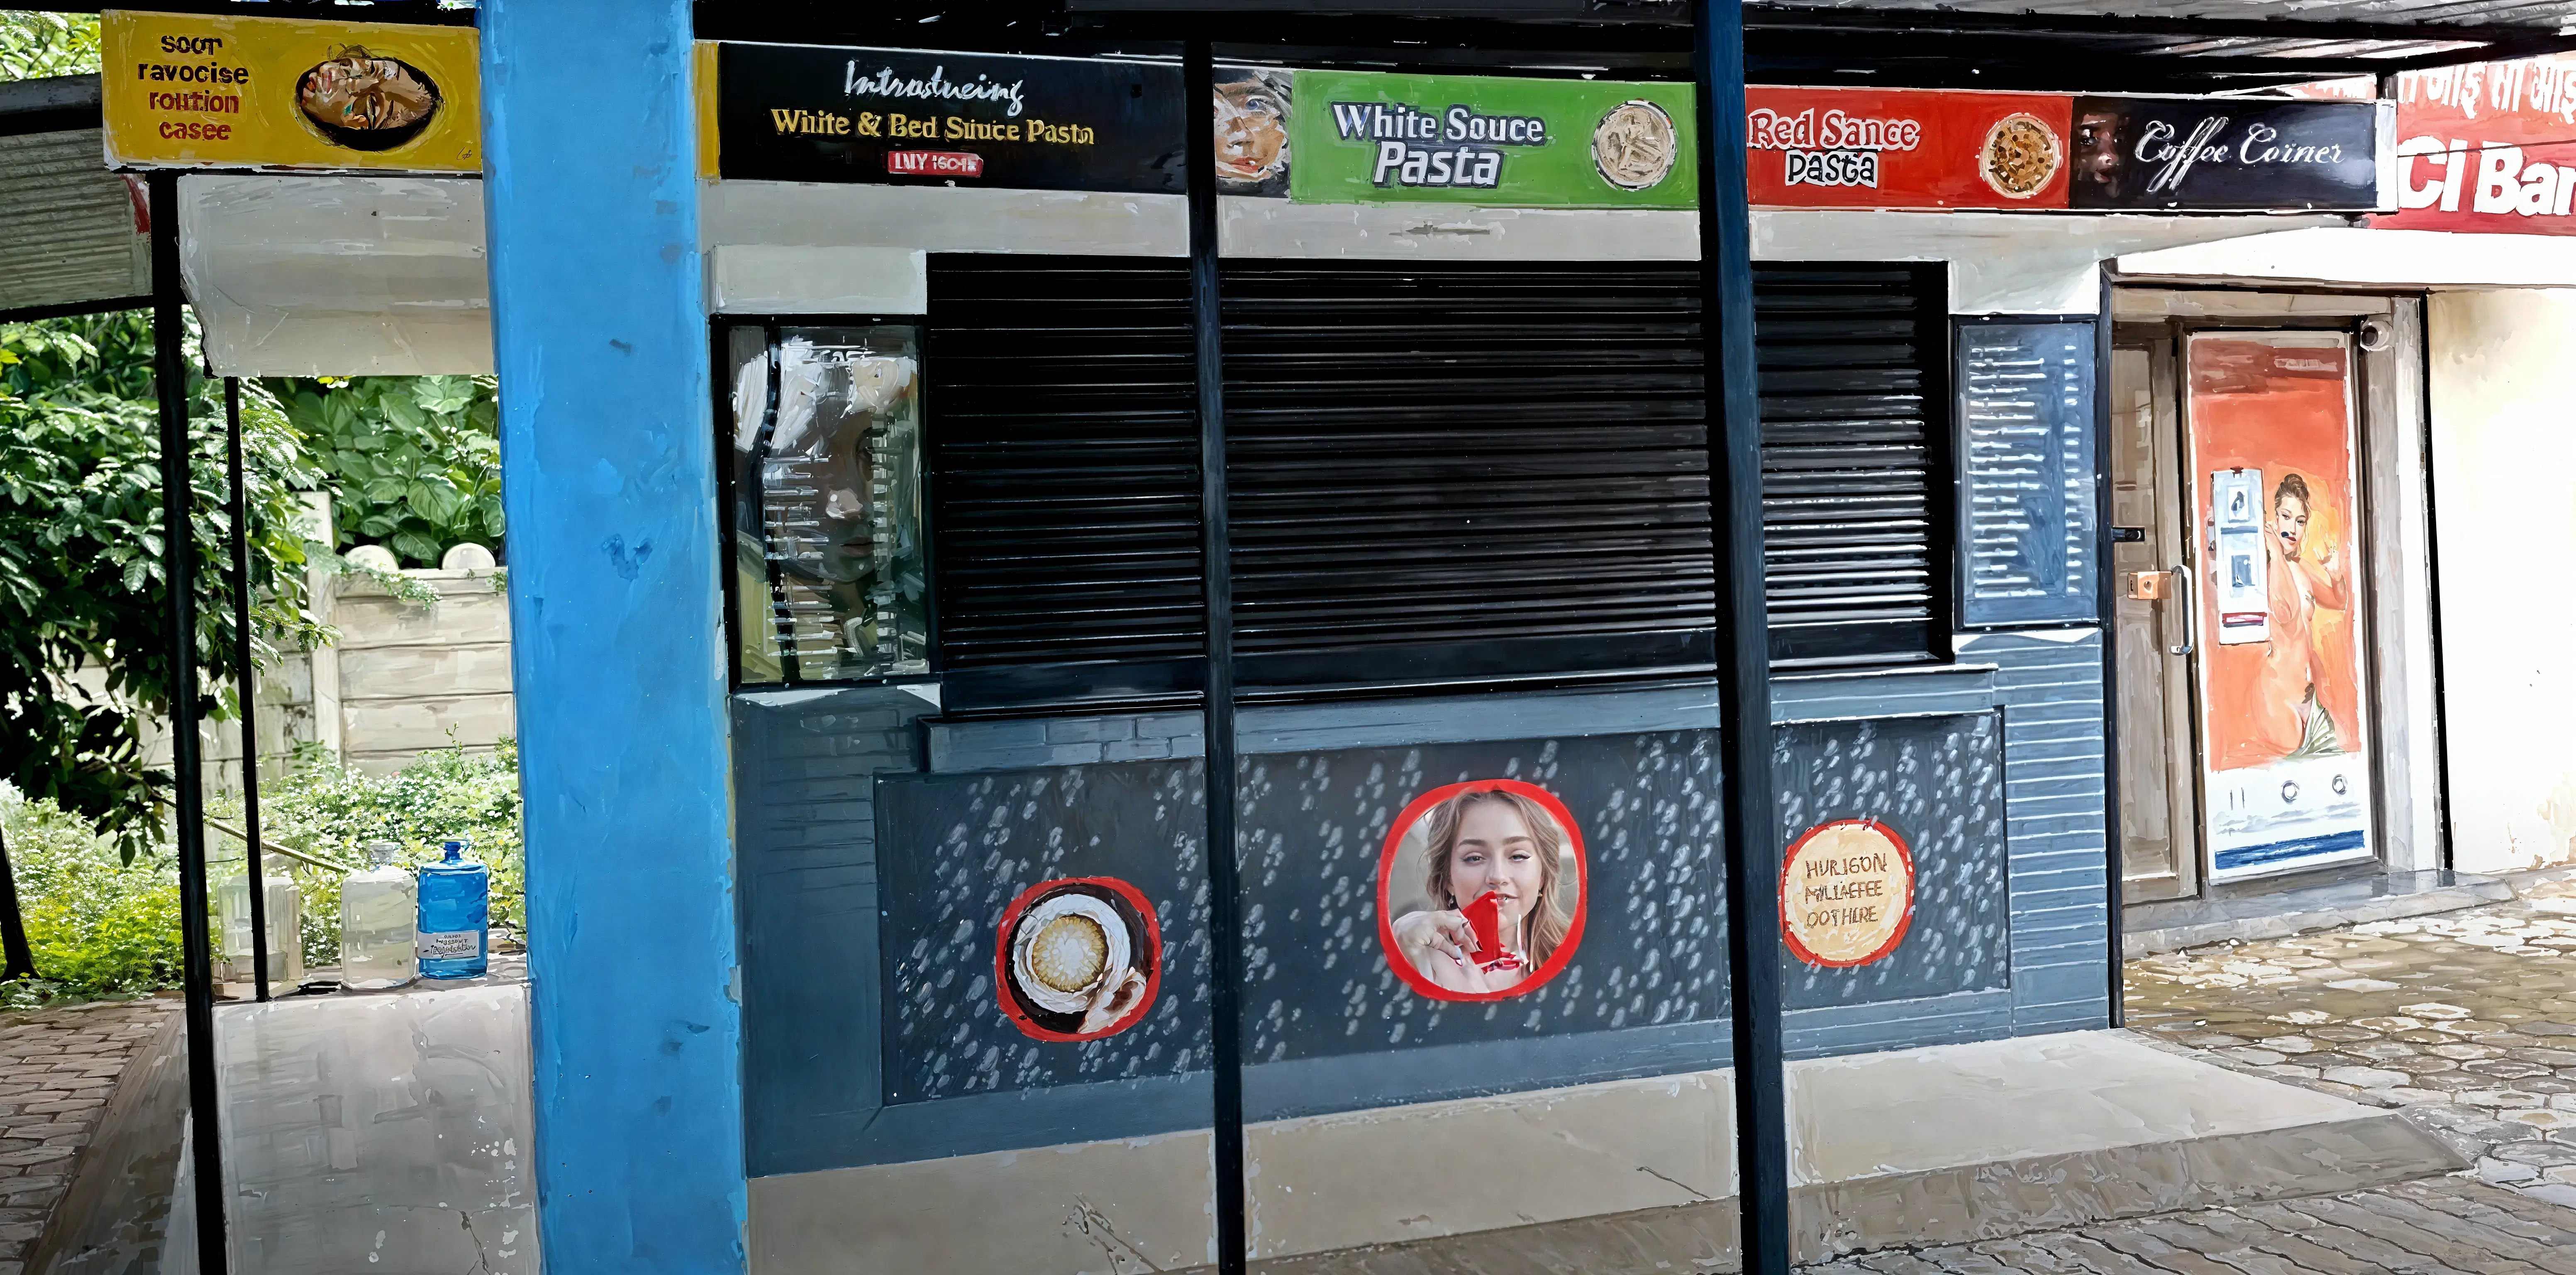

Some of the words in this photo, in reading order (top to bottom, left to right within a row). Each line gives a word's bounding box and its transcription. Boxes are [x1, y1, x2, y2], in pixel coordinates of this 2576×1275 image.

[857, 111, 883, 137] &
[1331, 102, 1439, 139] White
[1748, 109, 1815, 148] Red
[1372, 140, 1502, 187] Pasta
[1787, 151, 1877, 186] Pasta
